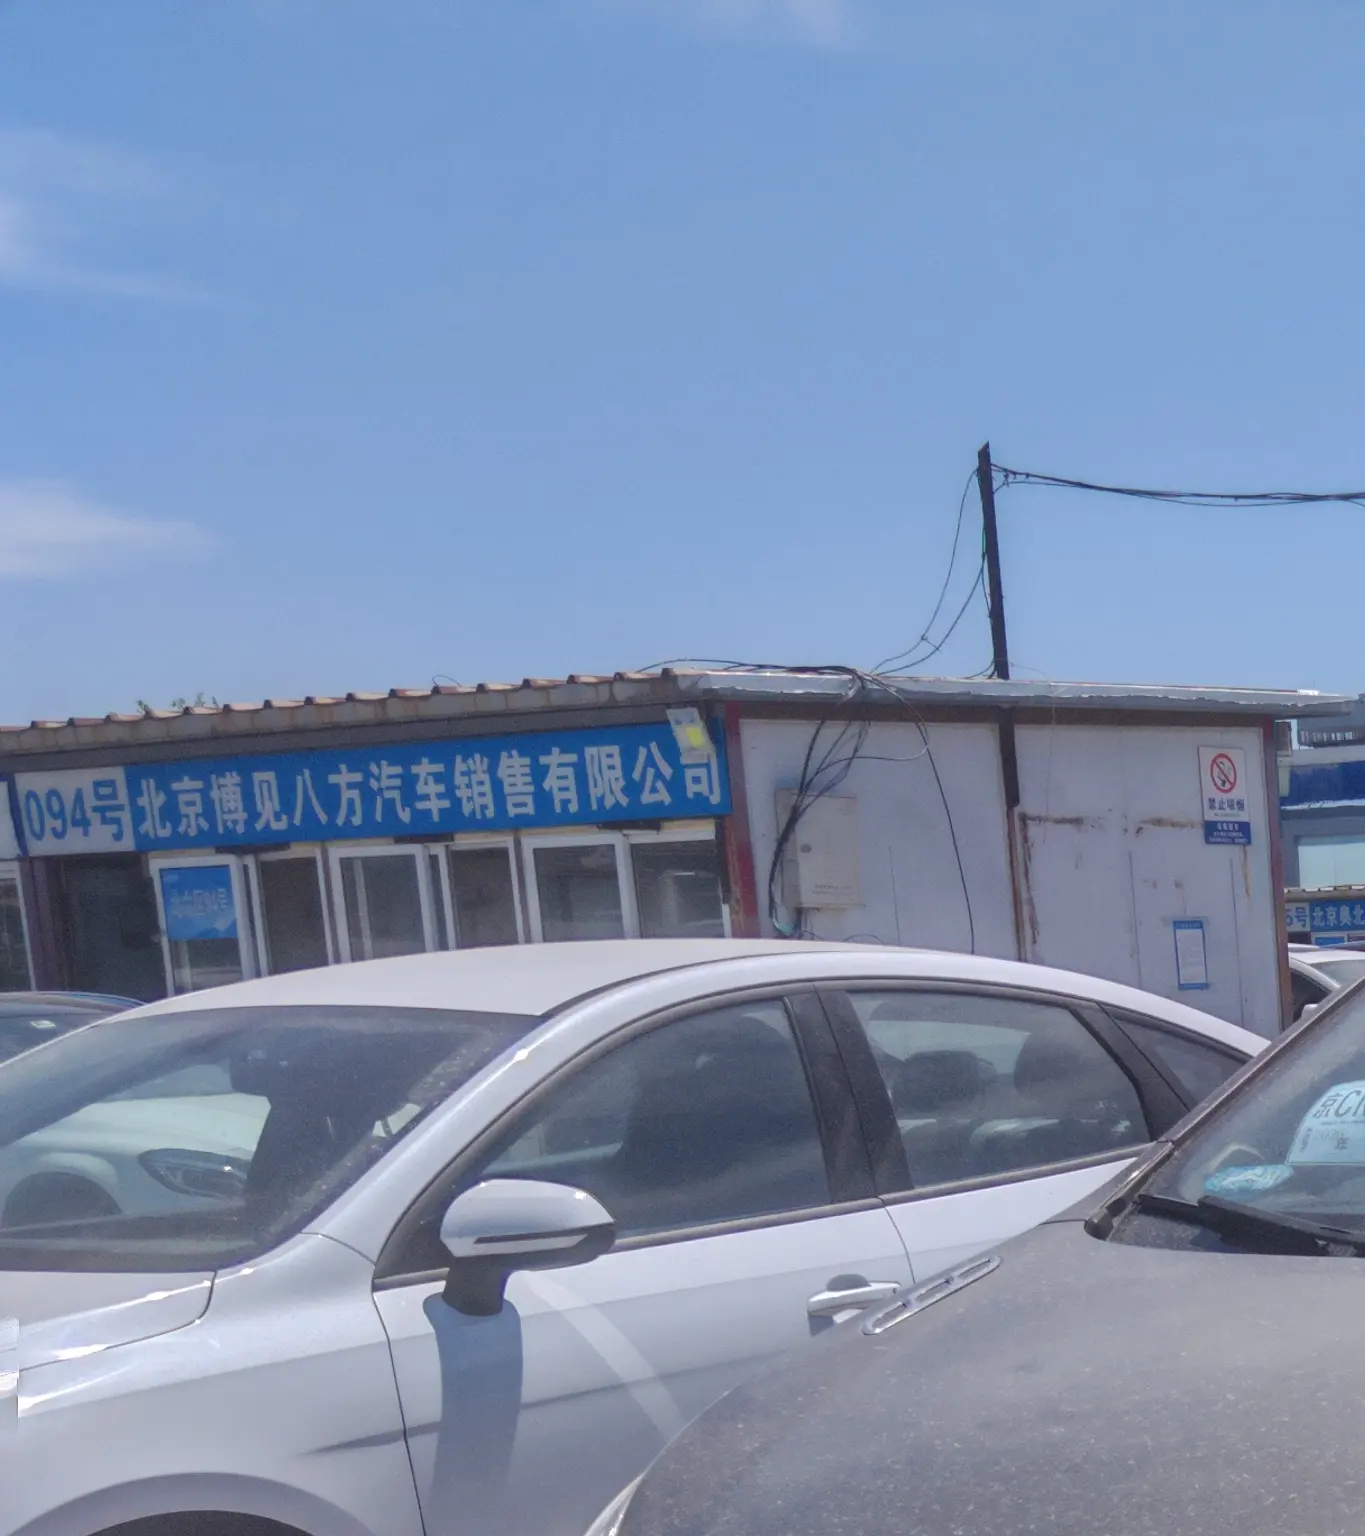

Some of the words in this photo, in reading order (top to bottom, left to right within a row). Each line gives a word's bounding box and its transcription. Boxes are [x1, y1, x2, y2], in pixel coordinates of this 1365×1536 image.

[24, 778, 126, 843] 094号
[136, 741, 721, 840] 北京博见八方汽车销售有限公司
